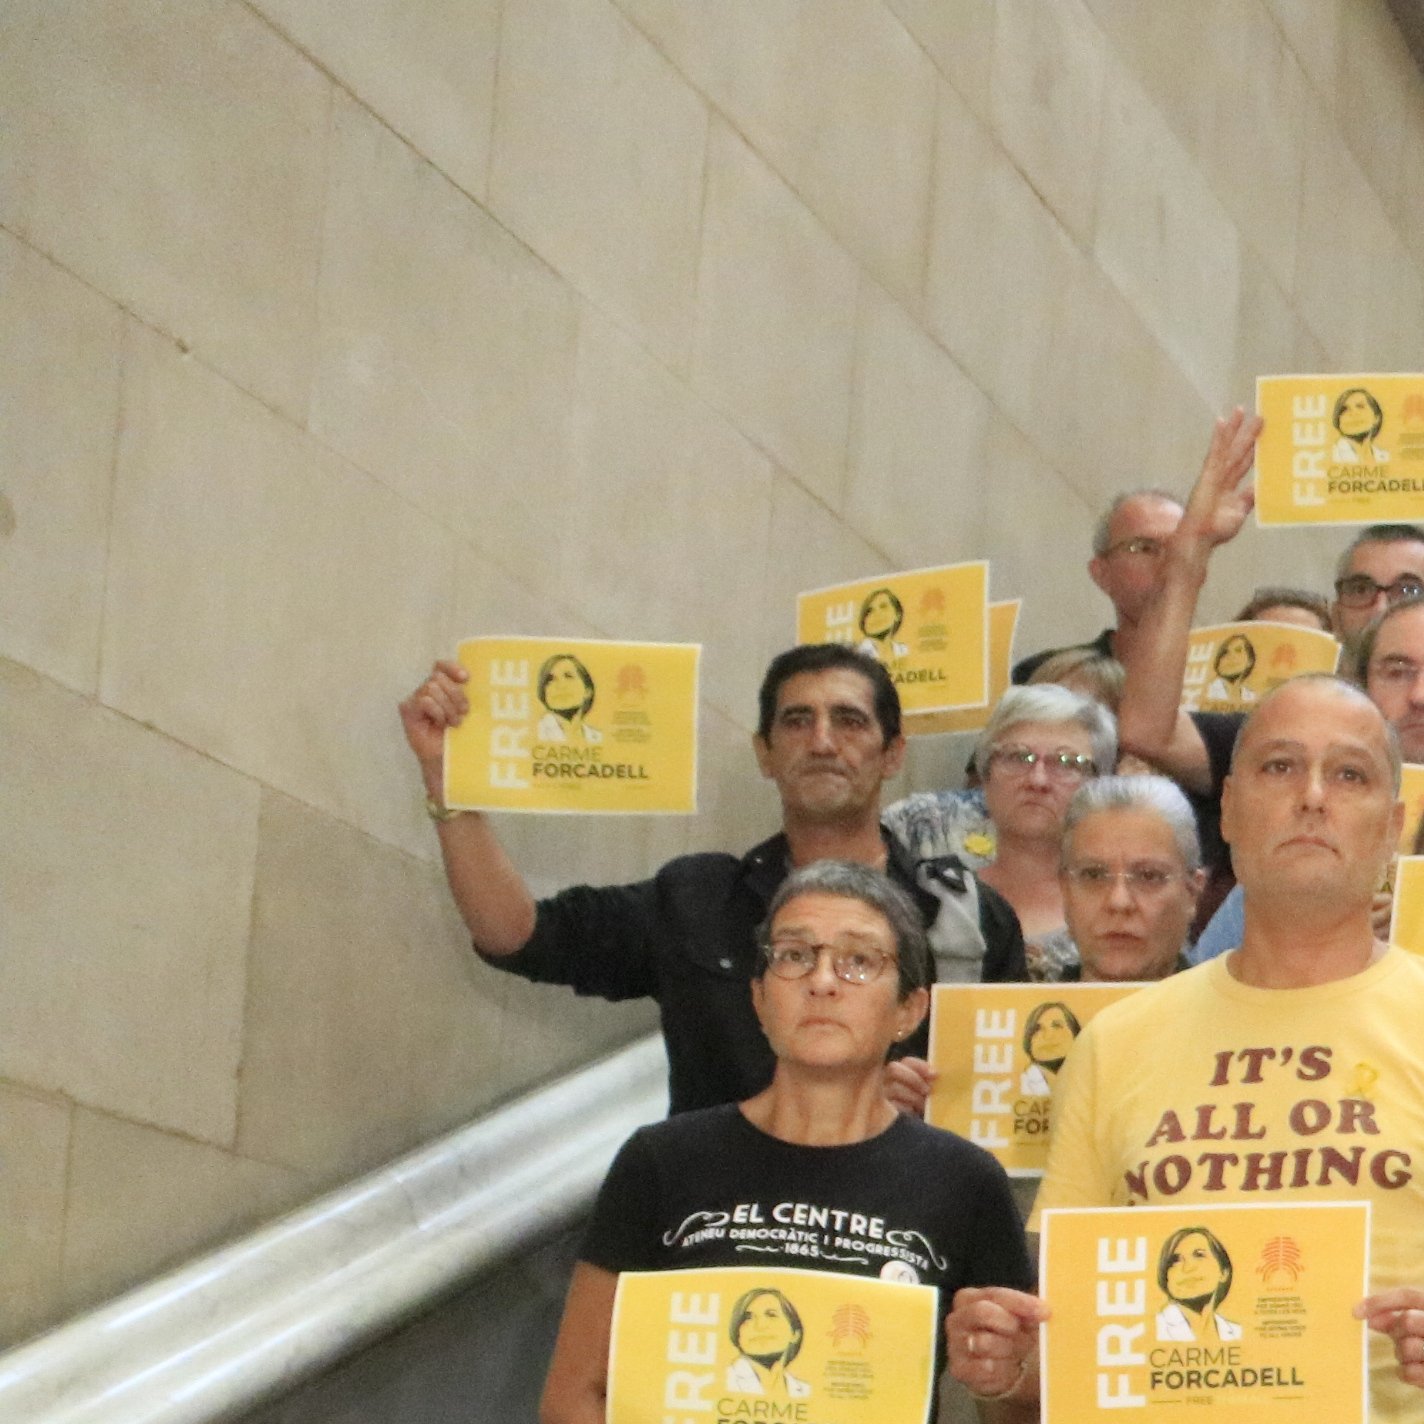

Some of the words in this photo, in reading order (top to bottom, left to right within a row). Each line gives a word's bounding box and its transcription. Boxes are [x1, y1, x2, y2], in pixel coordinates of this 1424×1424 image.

[1293, 394, 1326, 506] FREE
[1327, 465, 1390, 478] CARME
[490, 659, 530, 789] FREE
[532, 746, 602, 761] CARME
[532, 763, 649, 779] FORCADELL
[970, 1008, 1016, 1148] FREE
[1209, 1046, 1333, 1087] IT'S
[1144, 1101, 1267, 1148] ALL
[1289, 1099, 1381, 1136] OR
[1123, 1146, 1412, 1206] NOTHING
[733, 1203, 764, 1224] EL
[772, 1203, 885, 1240] CENTRE
[682, 1229, 726, 1247] ATENEU
[729, 1228, 818, 1243] DEMOCRÀTIC
[823, 1234, 830, 1245] I
[834, 1236, 929, 1270] PROGRESSISTA
[785, 1242, 819, 1258] 1865
[1096, 1236, 1147, 1410] FREE
[1150, 1346, 1241, 1368] CARME
[1150, 1366, 1305, 1390] FORCADELL
[716, 1397, 809, 1422] CARME
